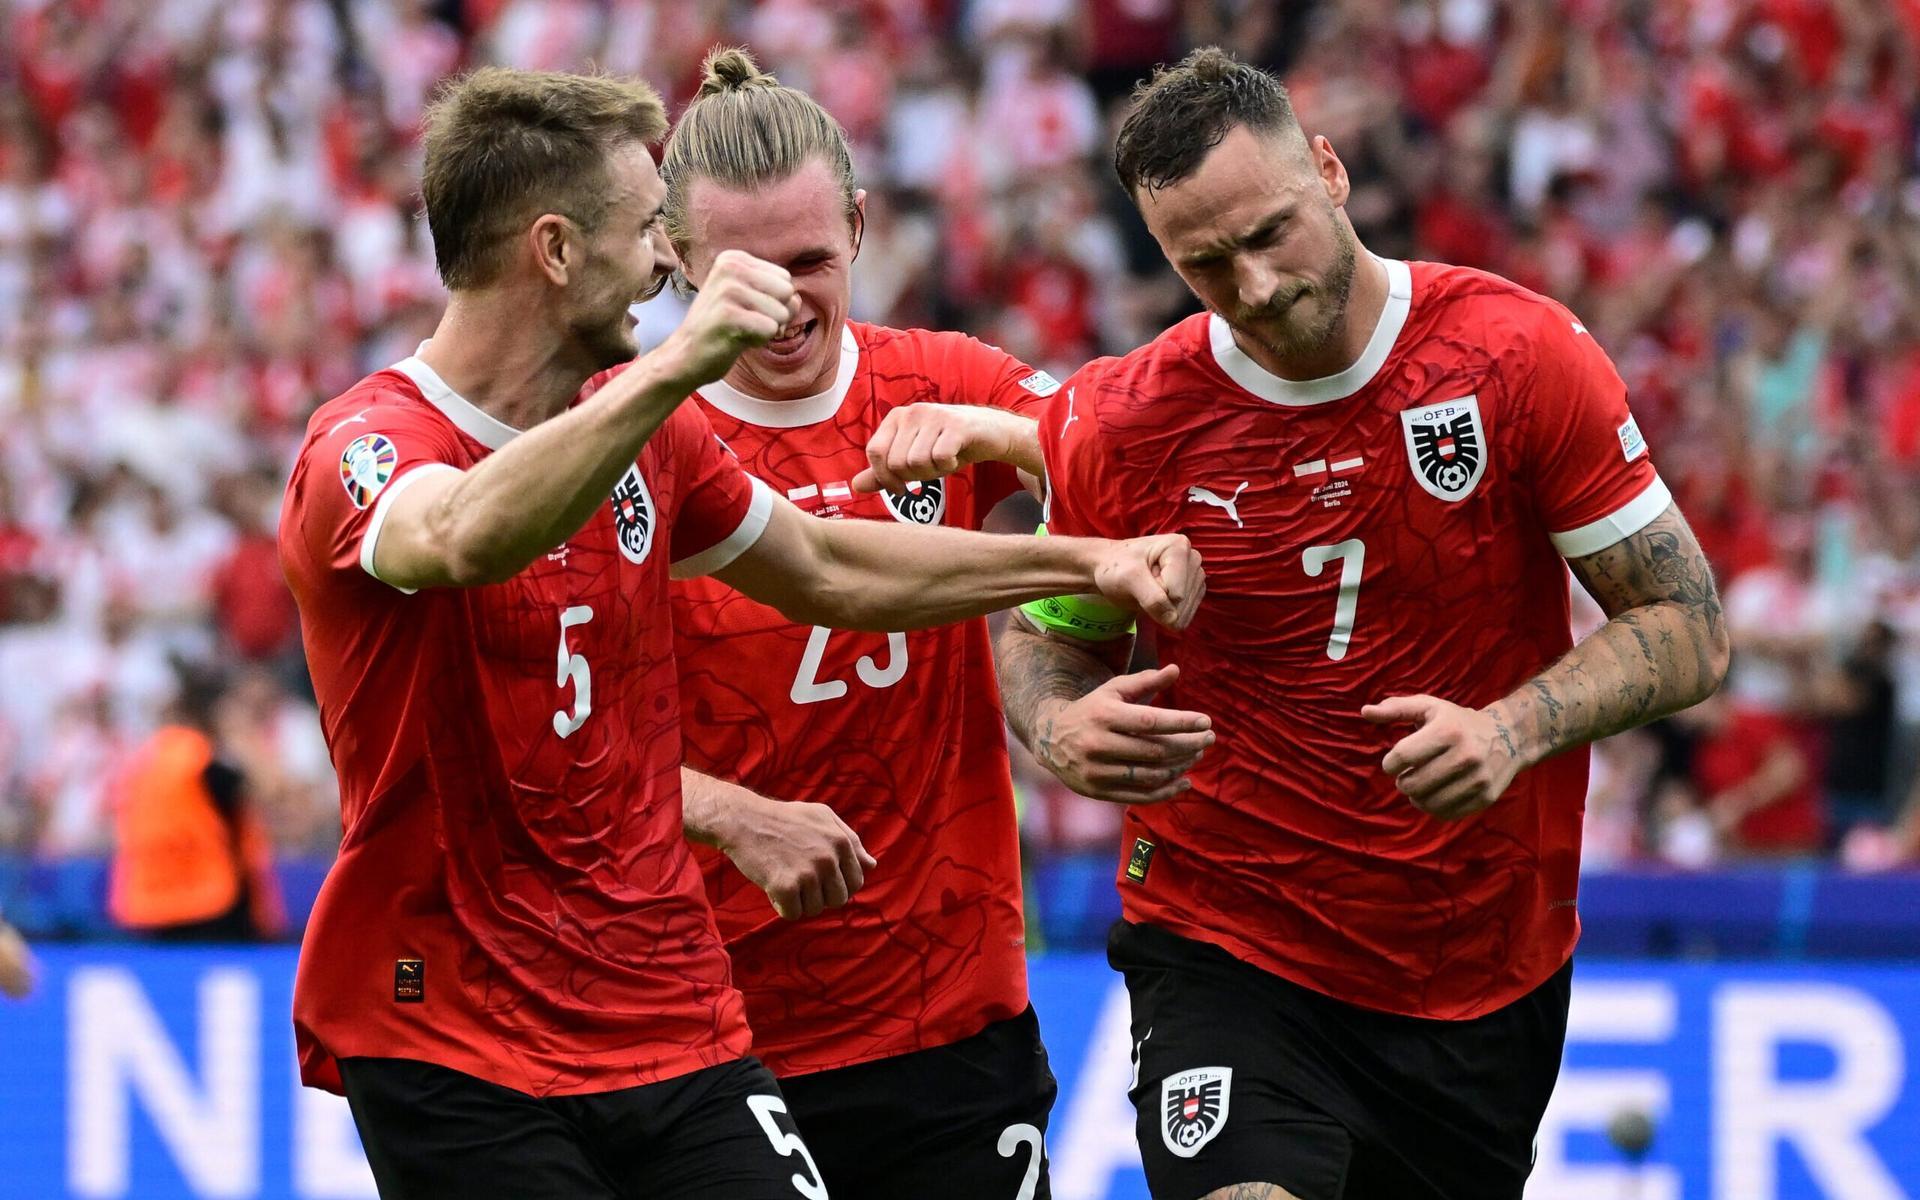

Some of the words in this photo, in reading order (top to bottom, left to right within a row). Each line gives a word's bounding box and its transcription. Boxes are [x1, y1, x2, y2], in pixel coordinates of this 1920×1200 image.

[1423, 407, 1456, 421] ÖFB
[1302, 538, 1366, 661] 7
[553, 605, 594, 739] 5
[747, 1095, 829, 1200] 5
